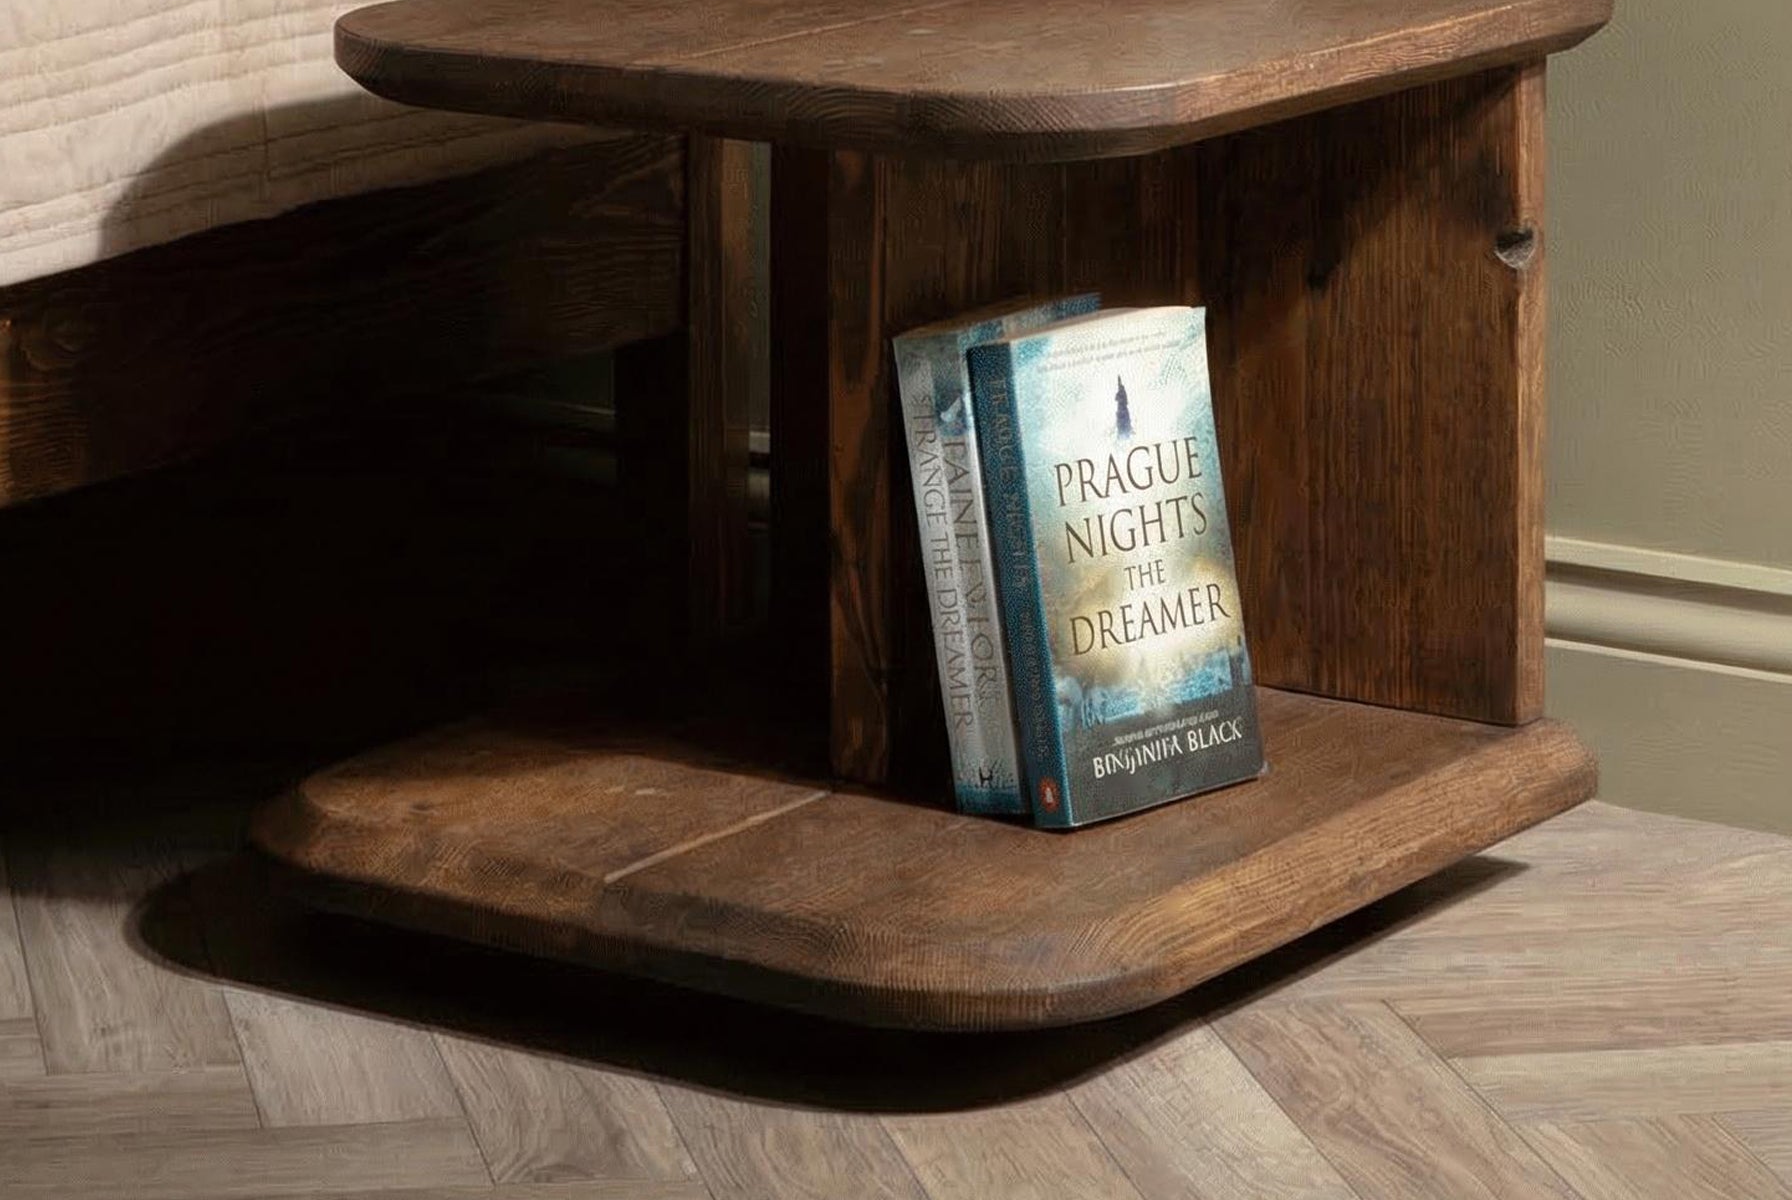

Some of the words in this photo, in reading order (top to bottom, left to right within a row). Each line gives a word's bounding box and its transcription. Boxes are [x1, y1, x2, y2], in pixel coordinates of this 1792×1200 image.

[1054, 436, 1202, 507] PRAGUE
[930, 532, 953, 579] THE
[1065, 492, 1207, 564] NIGHTS
[1124, 559, 1165, 591] THE
[1069, 583, 1231, 655] DREAMER
[936, 588, 974, 729] DREAMER
[1187, 718, 1243, 752] BLACK
